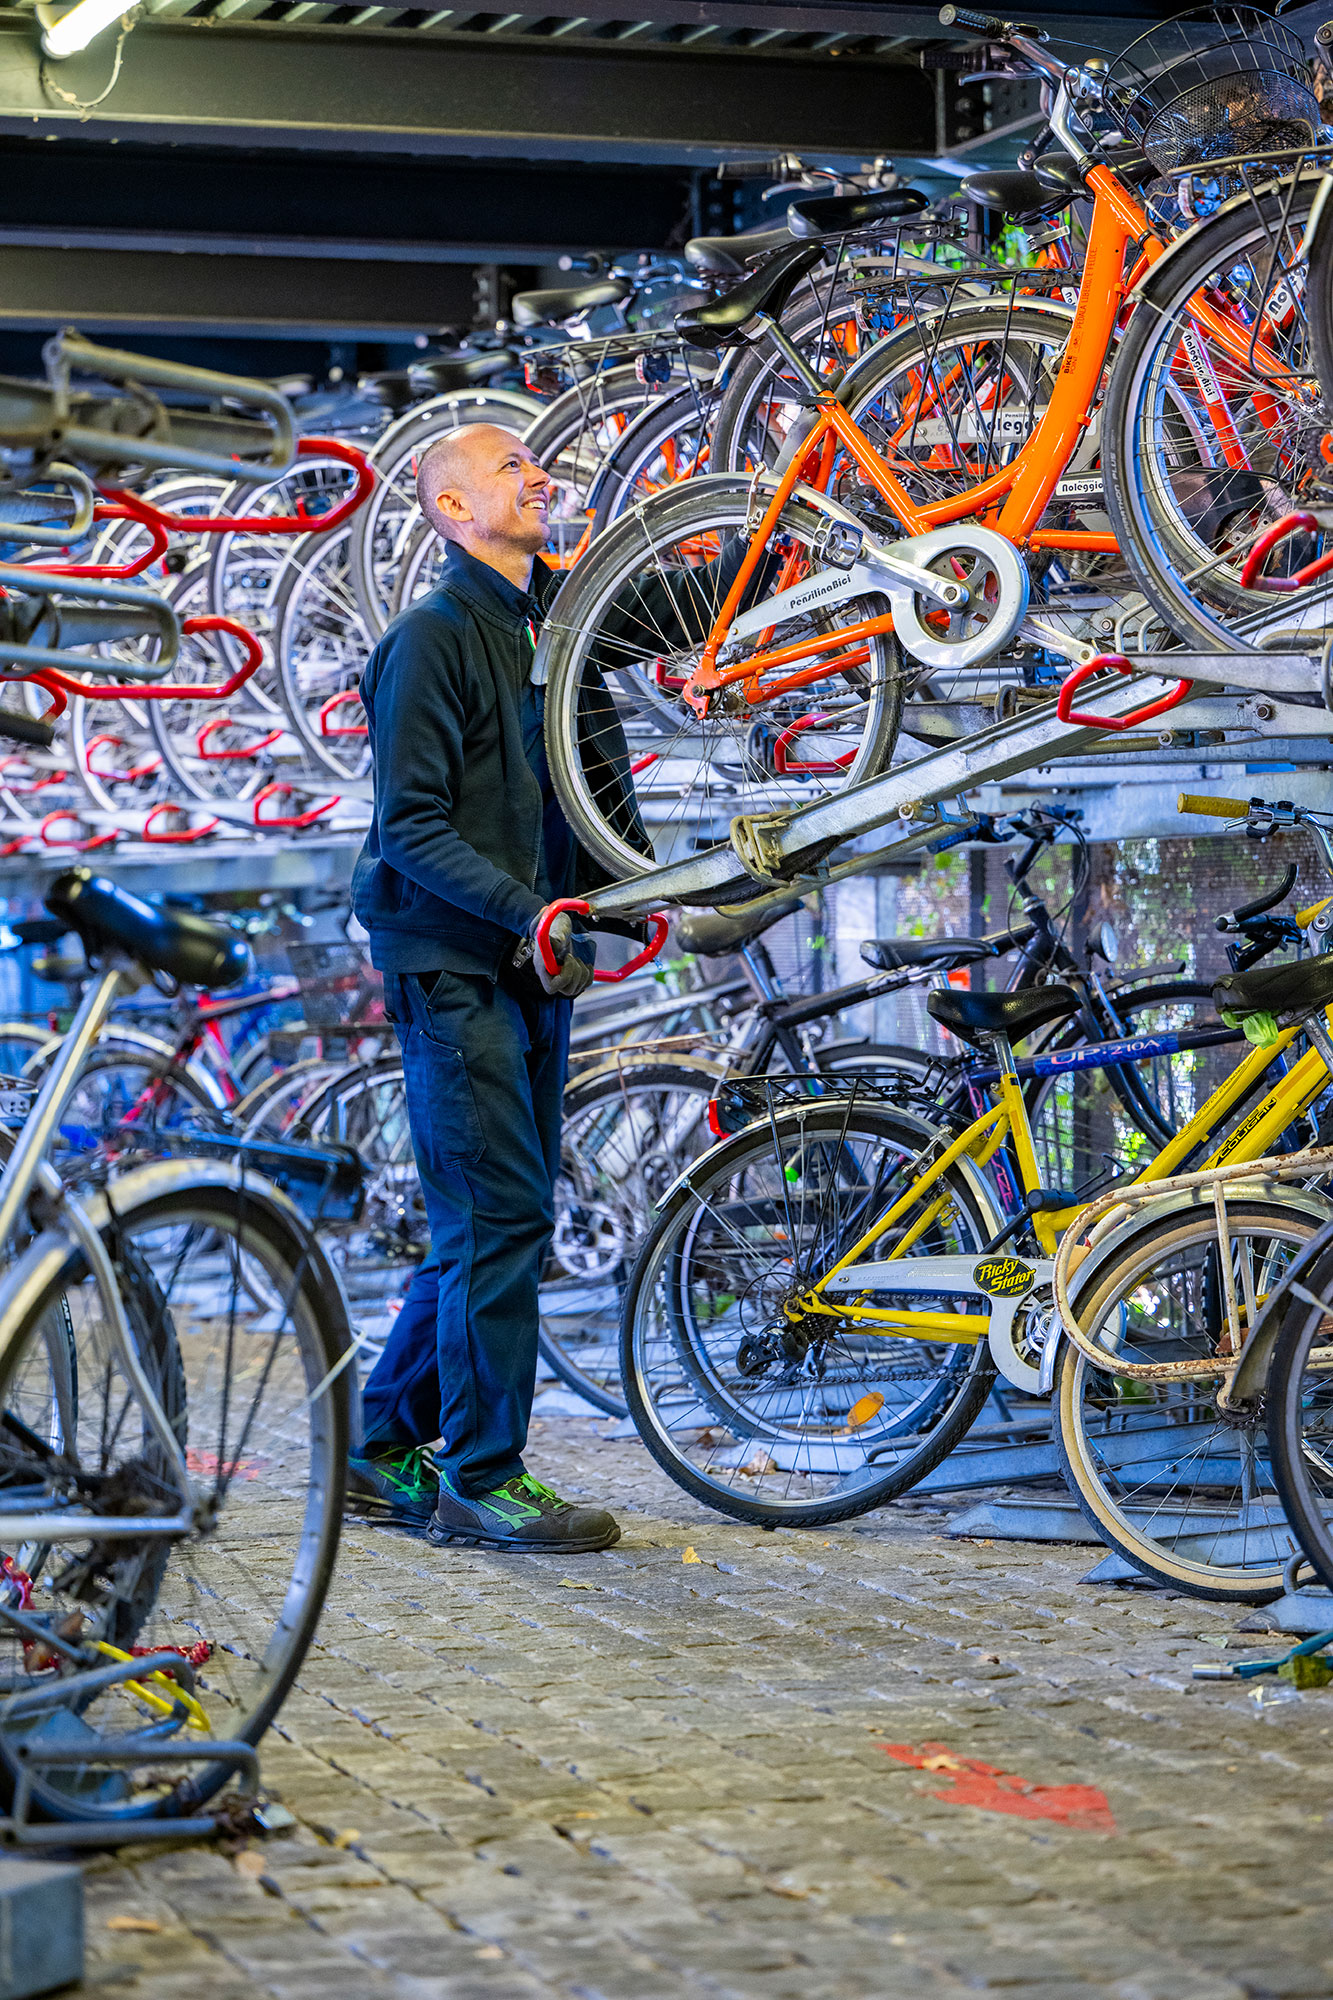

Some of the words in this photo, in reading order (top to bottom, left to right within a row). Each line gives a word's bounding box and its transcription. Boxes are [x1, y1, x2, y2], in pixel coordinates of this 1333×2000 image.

[1064, 355, 1073, 374] BIKE
[1110, 452, 1119, 480] PLUS
[1114, 484, 1133, 537] MARATHON
[789, 573, 852, 609] PensilinaBici
[978, 1258, 1019, 1282] Ricky
[987, 1269, 1037, 1294] Stator
[1007, 1284, 1024, 1295] .com
